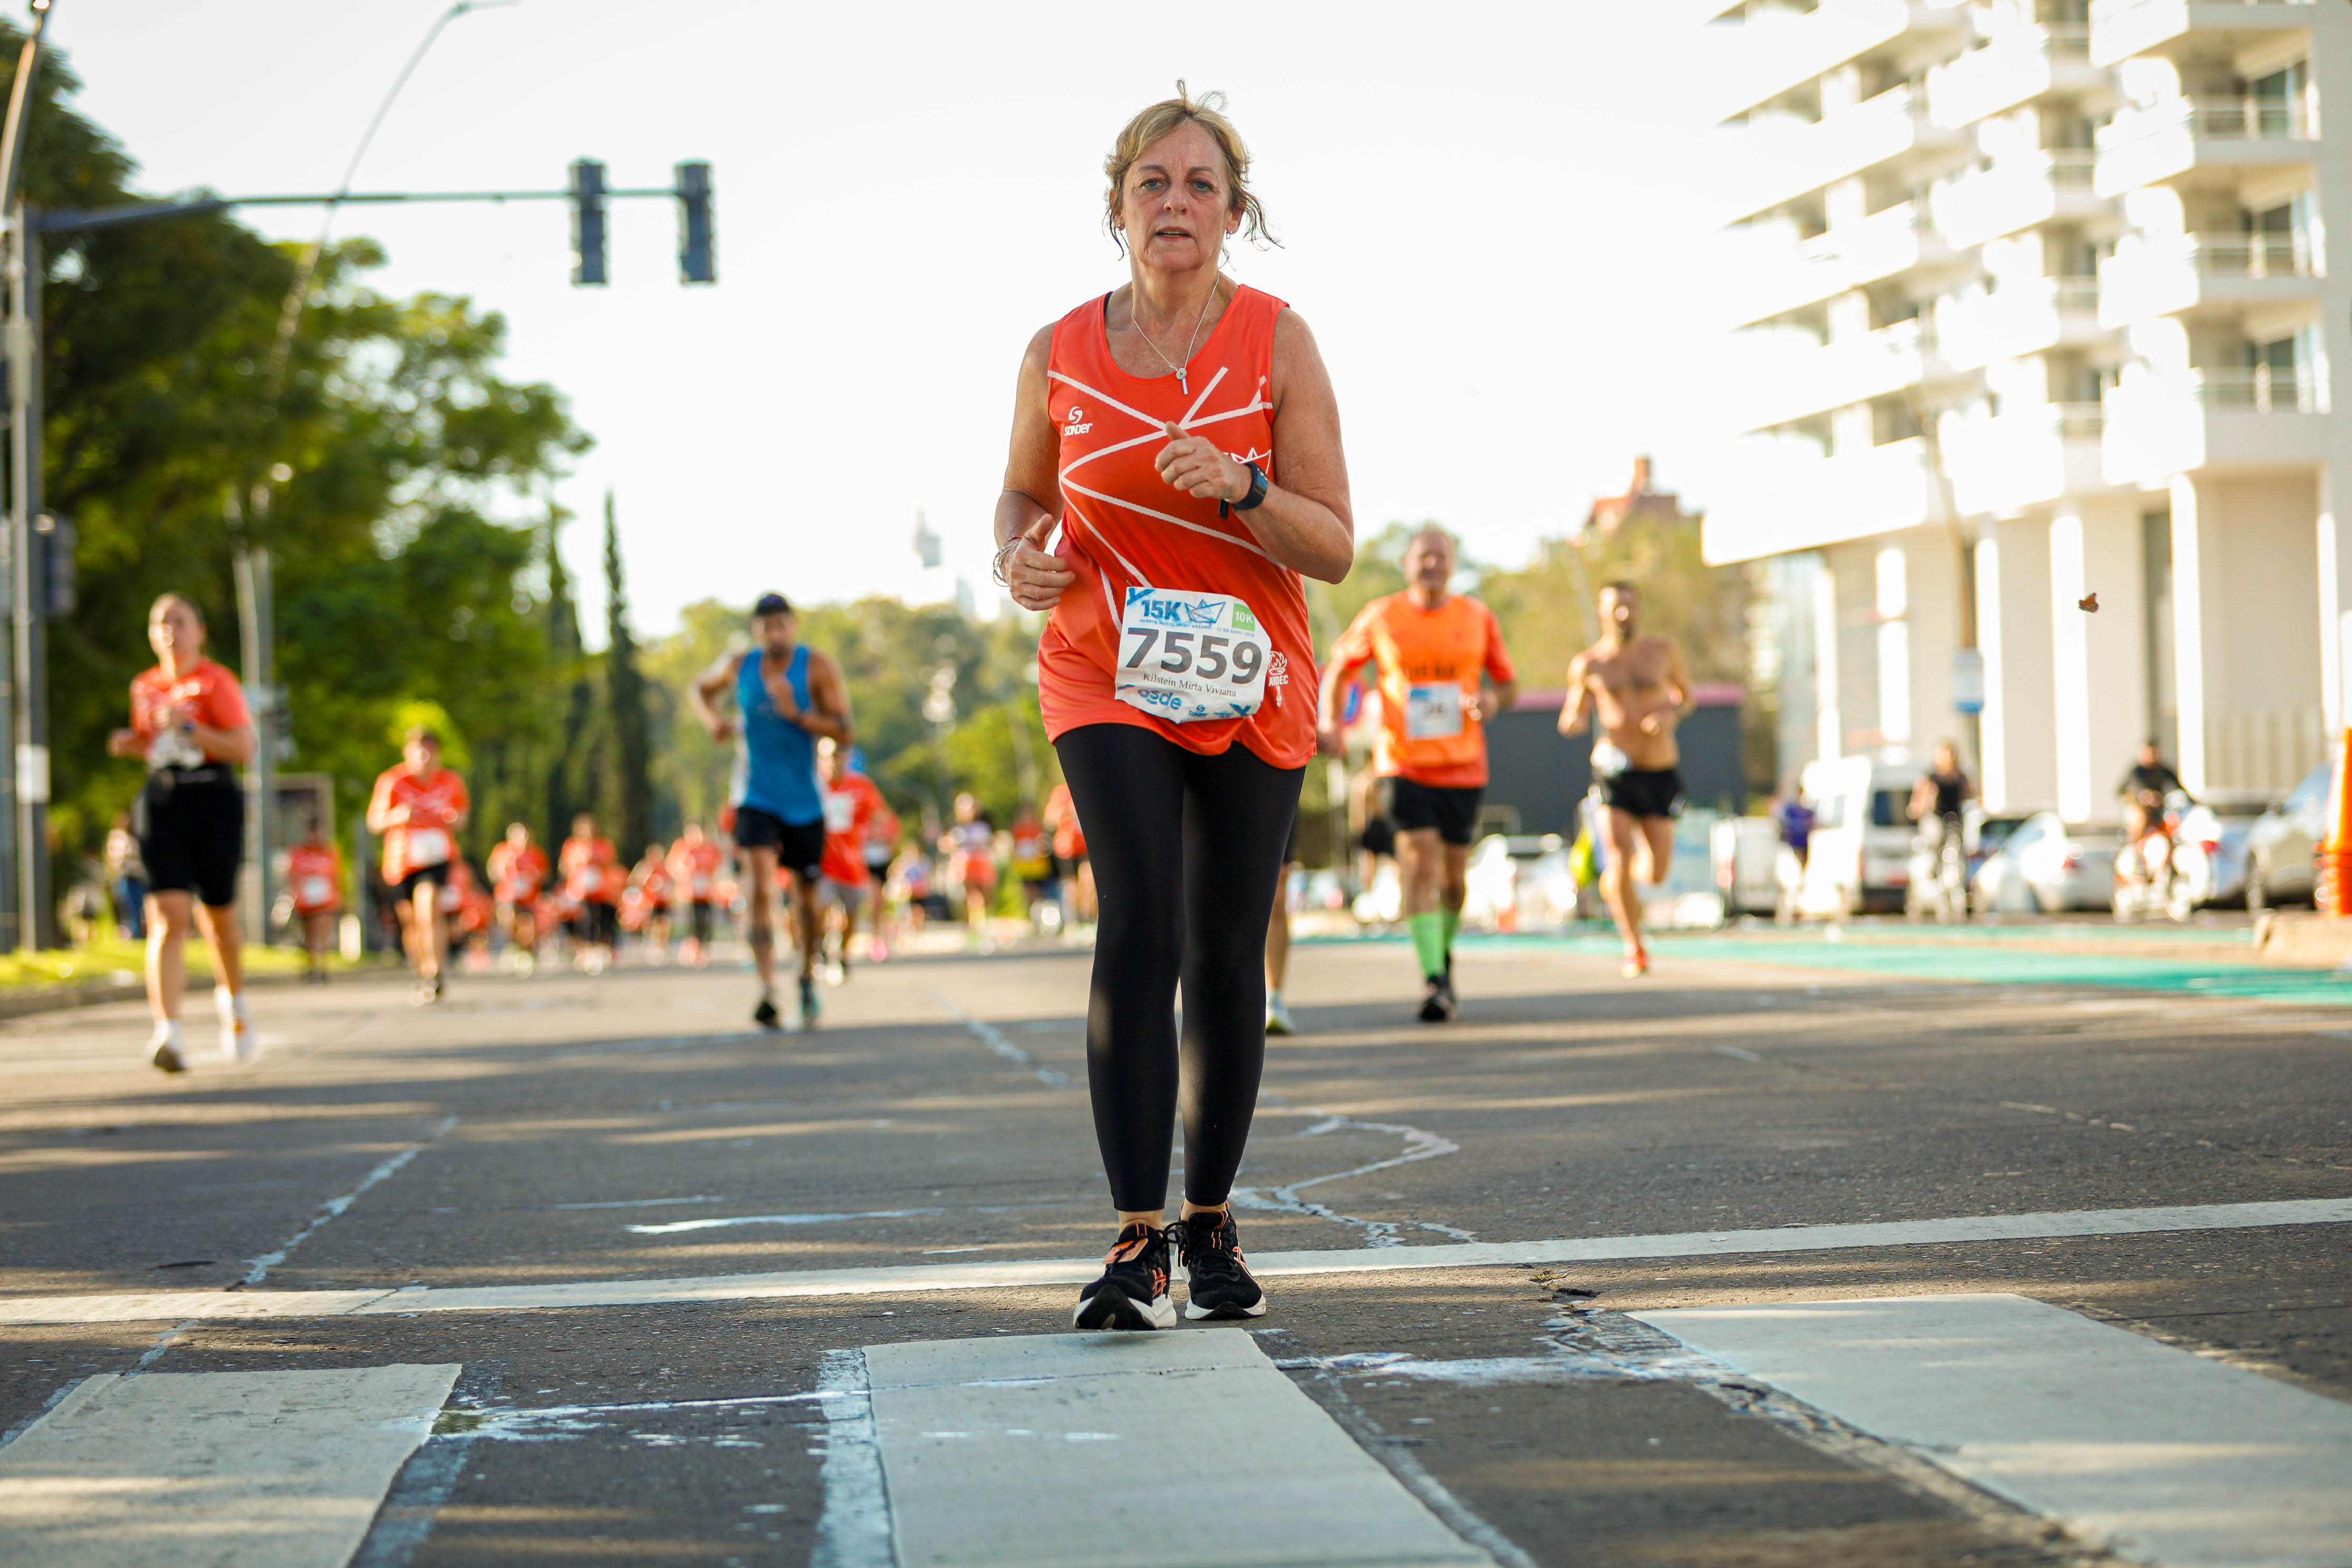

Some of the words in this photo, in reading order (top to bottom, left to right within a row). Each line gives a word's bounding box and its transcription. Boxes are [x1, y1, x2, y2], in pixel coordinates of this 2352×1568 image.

[1141, 600, 1182, 621] 15K
[1236, 611, 1253, 623] 10K
[1125, 627, 1262, 684] 7559
[1143, 673, 1176, 686] Kilstein
[1179, 680, 1202, 692] Mirta
[1206, 684, 1236, 697] Viviana
[1138, 689, 1182, 710] osde
